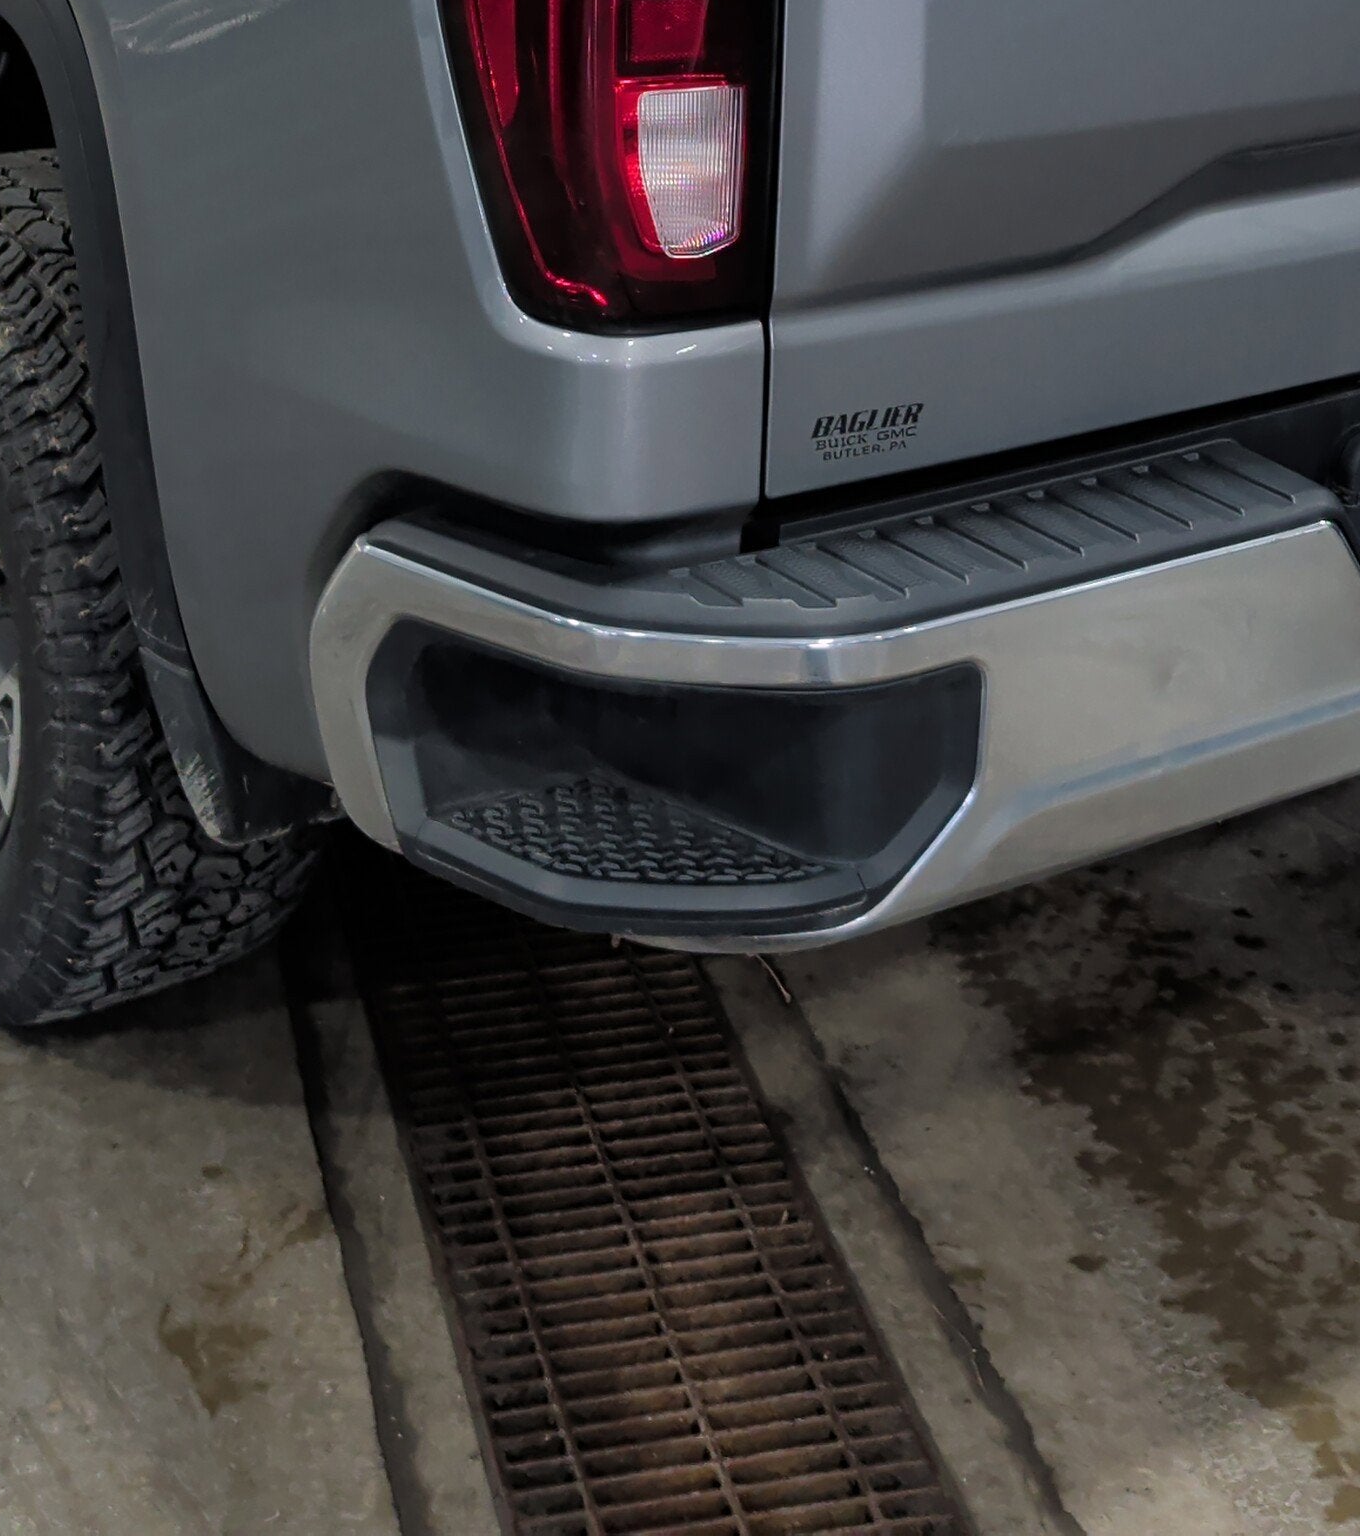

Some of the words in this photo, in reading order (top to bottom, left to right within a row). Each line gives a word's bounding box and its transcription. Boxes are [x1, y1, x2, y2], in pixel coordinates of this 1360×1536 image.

[811, 402, 924, 439] BAGLIER
[815, 434, 868, 451] BUICK
[876, 425, 917, 441] GMC
[889, 440, 907, 451] PA
